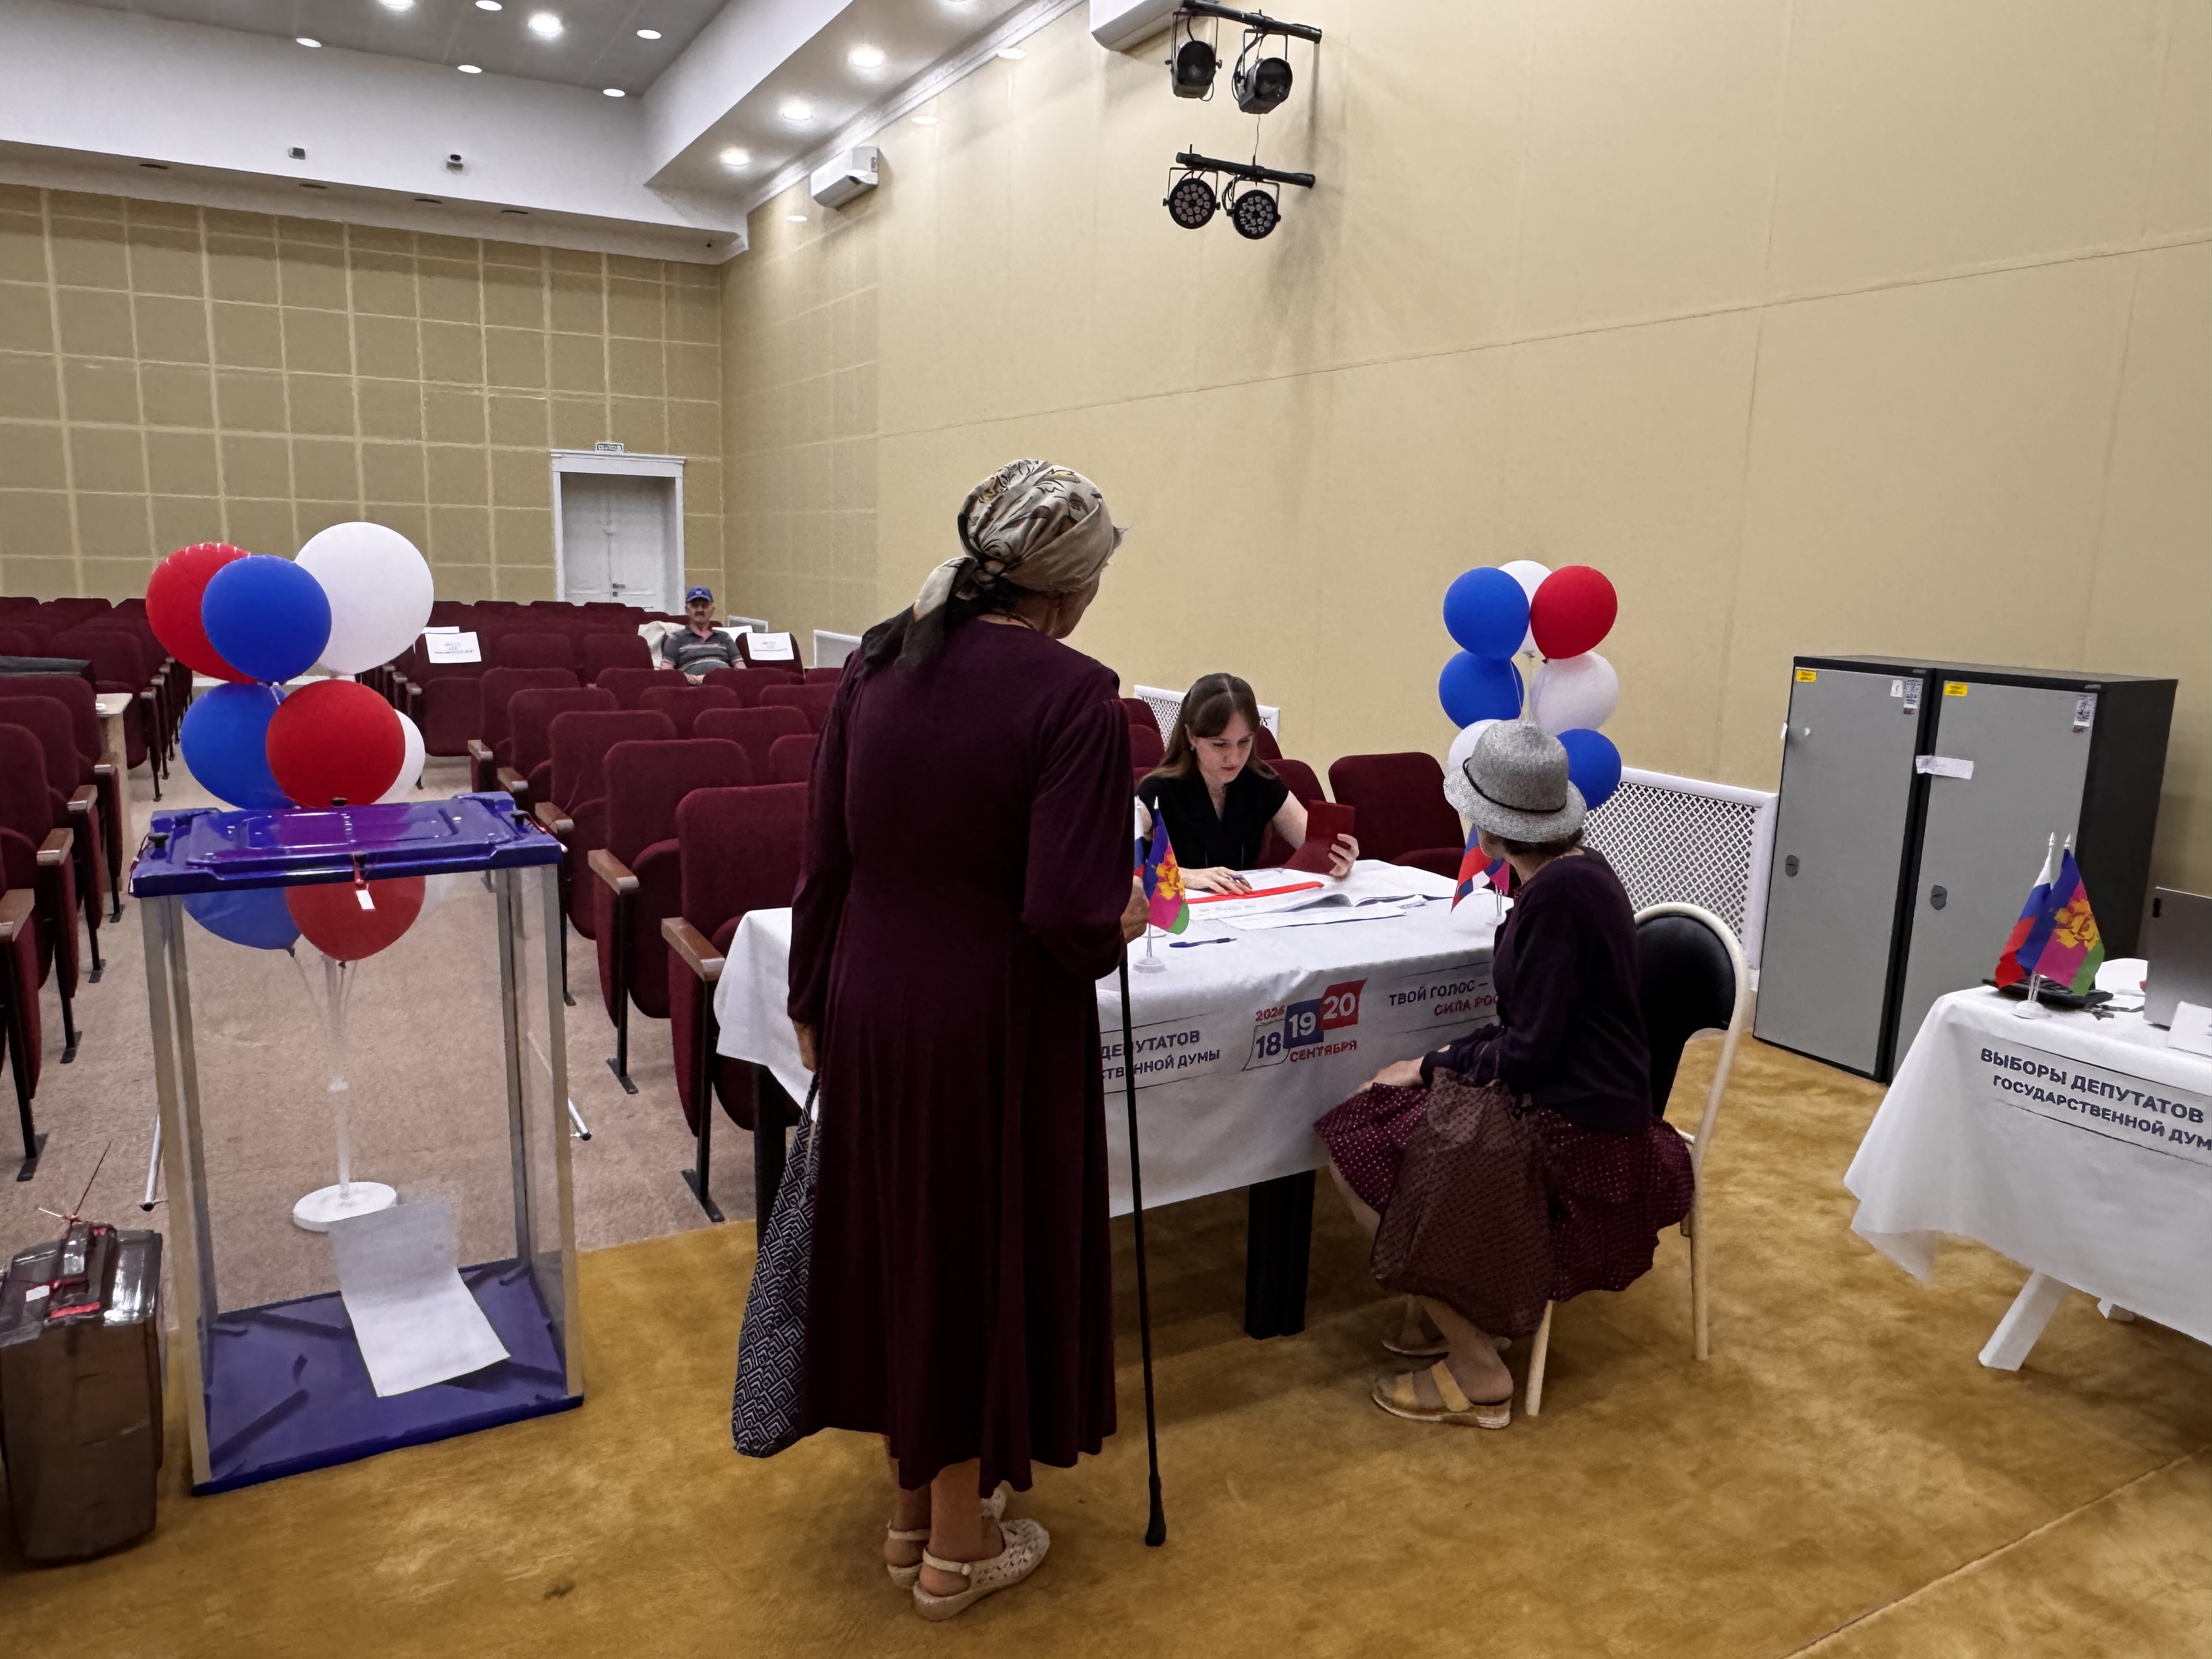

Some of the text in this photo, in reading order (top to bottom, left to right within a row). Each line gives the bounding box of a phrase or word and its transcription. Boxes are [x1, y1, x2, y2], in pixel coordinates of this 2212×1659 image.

[1323, 992, 1356, 1020] 20
[1389, 984, 1426, 1006] ТВОЙ
[1430, 980, 1475, 998] ГОЛОС
[1434, 999, 1471, 1015] СИЛА
[1289, 1012, 1317, 1038] 19
[1101, 1030, 1200, 1060] ДЕУТАТОВ
[1256, 1031, 1282, 1059] 18
[1290, 1040, 1357, 1062] СЕНТЯБРЯ
[1102, 1049, 1221, 1080] ТВННОЙ ДУМЫ
[1980, 1048, 2204, 1124] ВЫБОРЫ ДЕПУТАТОВ
[1993, 1074, 2211, 1150] ГОСУДАРСТВЕННОЙ ДУМ
